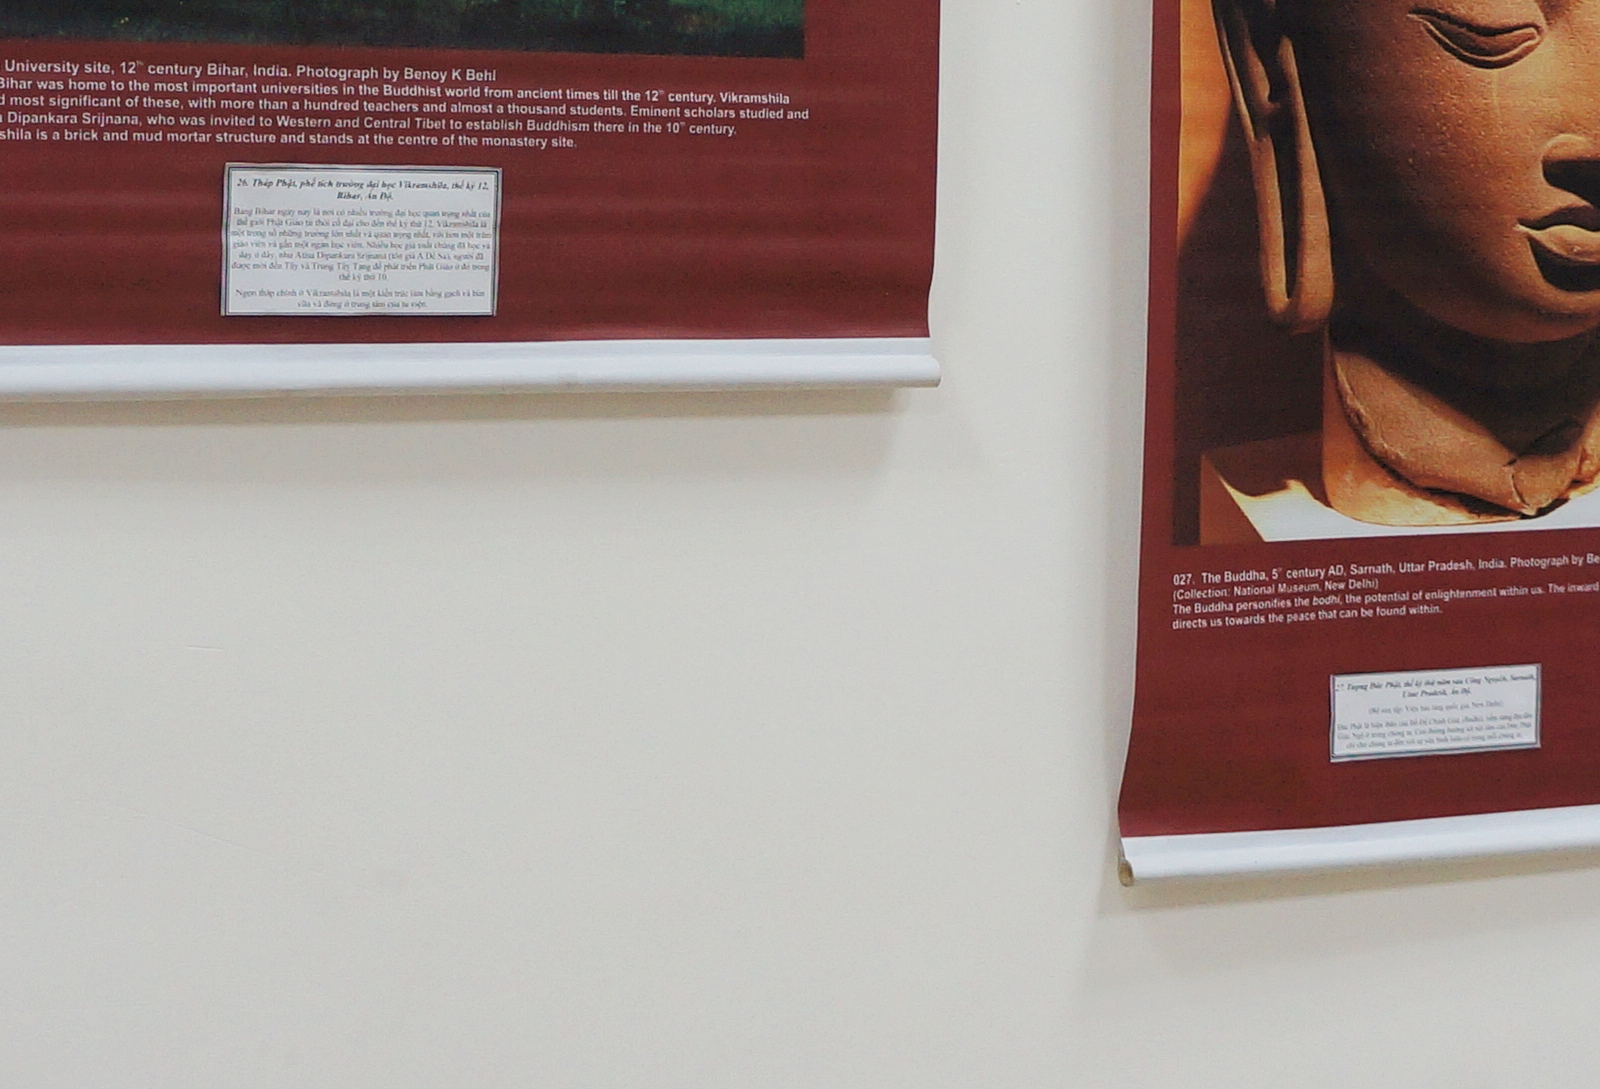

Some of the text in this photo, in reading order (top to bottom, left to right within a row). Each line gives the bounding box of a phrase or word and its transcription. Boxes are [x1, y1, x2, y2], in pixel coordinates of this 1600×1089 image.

[5, 59, 79, 76] University
[147, 64, 202, 78] century
[207, 63, 248, 77] Bihar,
[296, 65, 378, 81] Photograph
[383, 67, 399, 82] by
[404, 67, 447, 83] Benoy
[451, 68, 461, 80] K
[466, 68, 495, 81] Behl
[10, 95, 44, 106] most
[49, 95, 120, 109] significant
[125, 95, 139, 107] of
[142, 96, 183, 109] these,
[187, 97, 216, 108] with
[220, 99, 254, 109] more
[258, 98, 287, 109] than
[291, 101, 299, 110] a
[303, 99, 359, 111] hundred
[363, 100, 418, 112] teachers
[422, 102, 446, 112] and
[450, 102, 492, 113] almost
[496, 104, 503, 113] a
[507, 103, 566, 114] thousand
[569, 105, 627, 116] students.
[630, 104, 680, 117] Eminent
[684, 106, 735, 118] scholars
[739, 108, 783, 119] studied
[786, 109, 808, 119] and
[36, 128, 47, 140] is
[52, 131, 59, 140] a
[64, 129, 98, 140] brick
[102, 130, 128, 141] and
[132, 130, 162, 141] mud
[166, 131, 211, 142] mortar
[215, 132, 276, 143] structure
[280, 132, 304, 143] and
[309, 133, 353, 144] stands
[357, 133, 369, 144] at
[373, 133, 393, 144] the
[397, 135, 438, 145] centre
[441, 133, 454, 145] of
[458, 135, 478, 145] the
[481, 137, 547, 149] monastery
[551, 136, 576, 147] site.
[1201, 572, 1221, 583] The
[1224, 570, 1268, 582] Buddha,
[1286, 567, 1325, 579] century
[1328, 564, 1346, 576] AD,
[1398, 562, 1425, 573] Uttar
[1510, 555, 1569, 569] Photograph
[1571, 554, 1583, 566] by
[1233, 584, 1275, 596] National
[1324, 580, 1345, 590] New
[1172, 618, 1207, 629] directs
[1210, 618, 1222, 627] us
[1225, 614, 1265, 626] towards
[1268, 613, 1284, 623] the
[1286, 612, 1316, 623] peace
[1317, 609, 1337, 619] that
[1339, 609, 1358, 618] can
[1360, 607, 1373, 617] be
[1376, 605, 1406, 616] found
